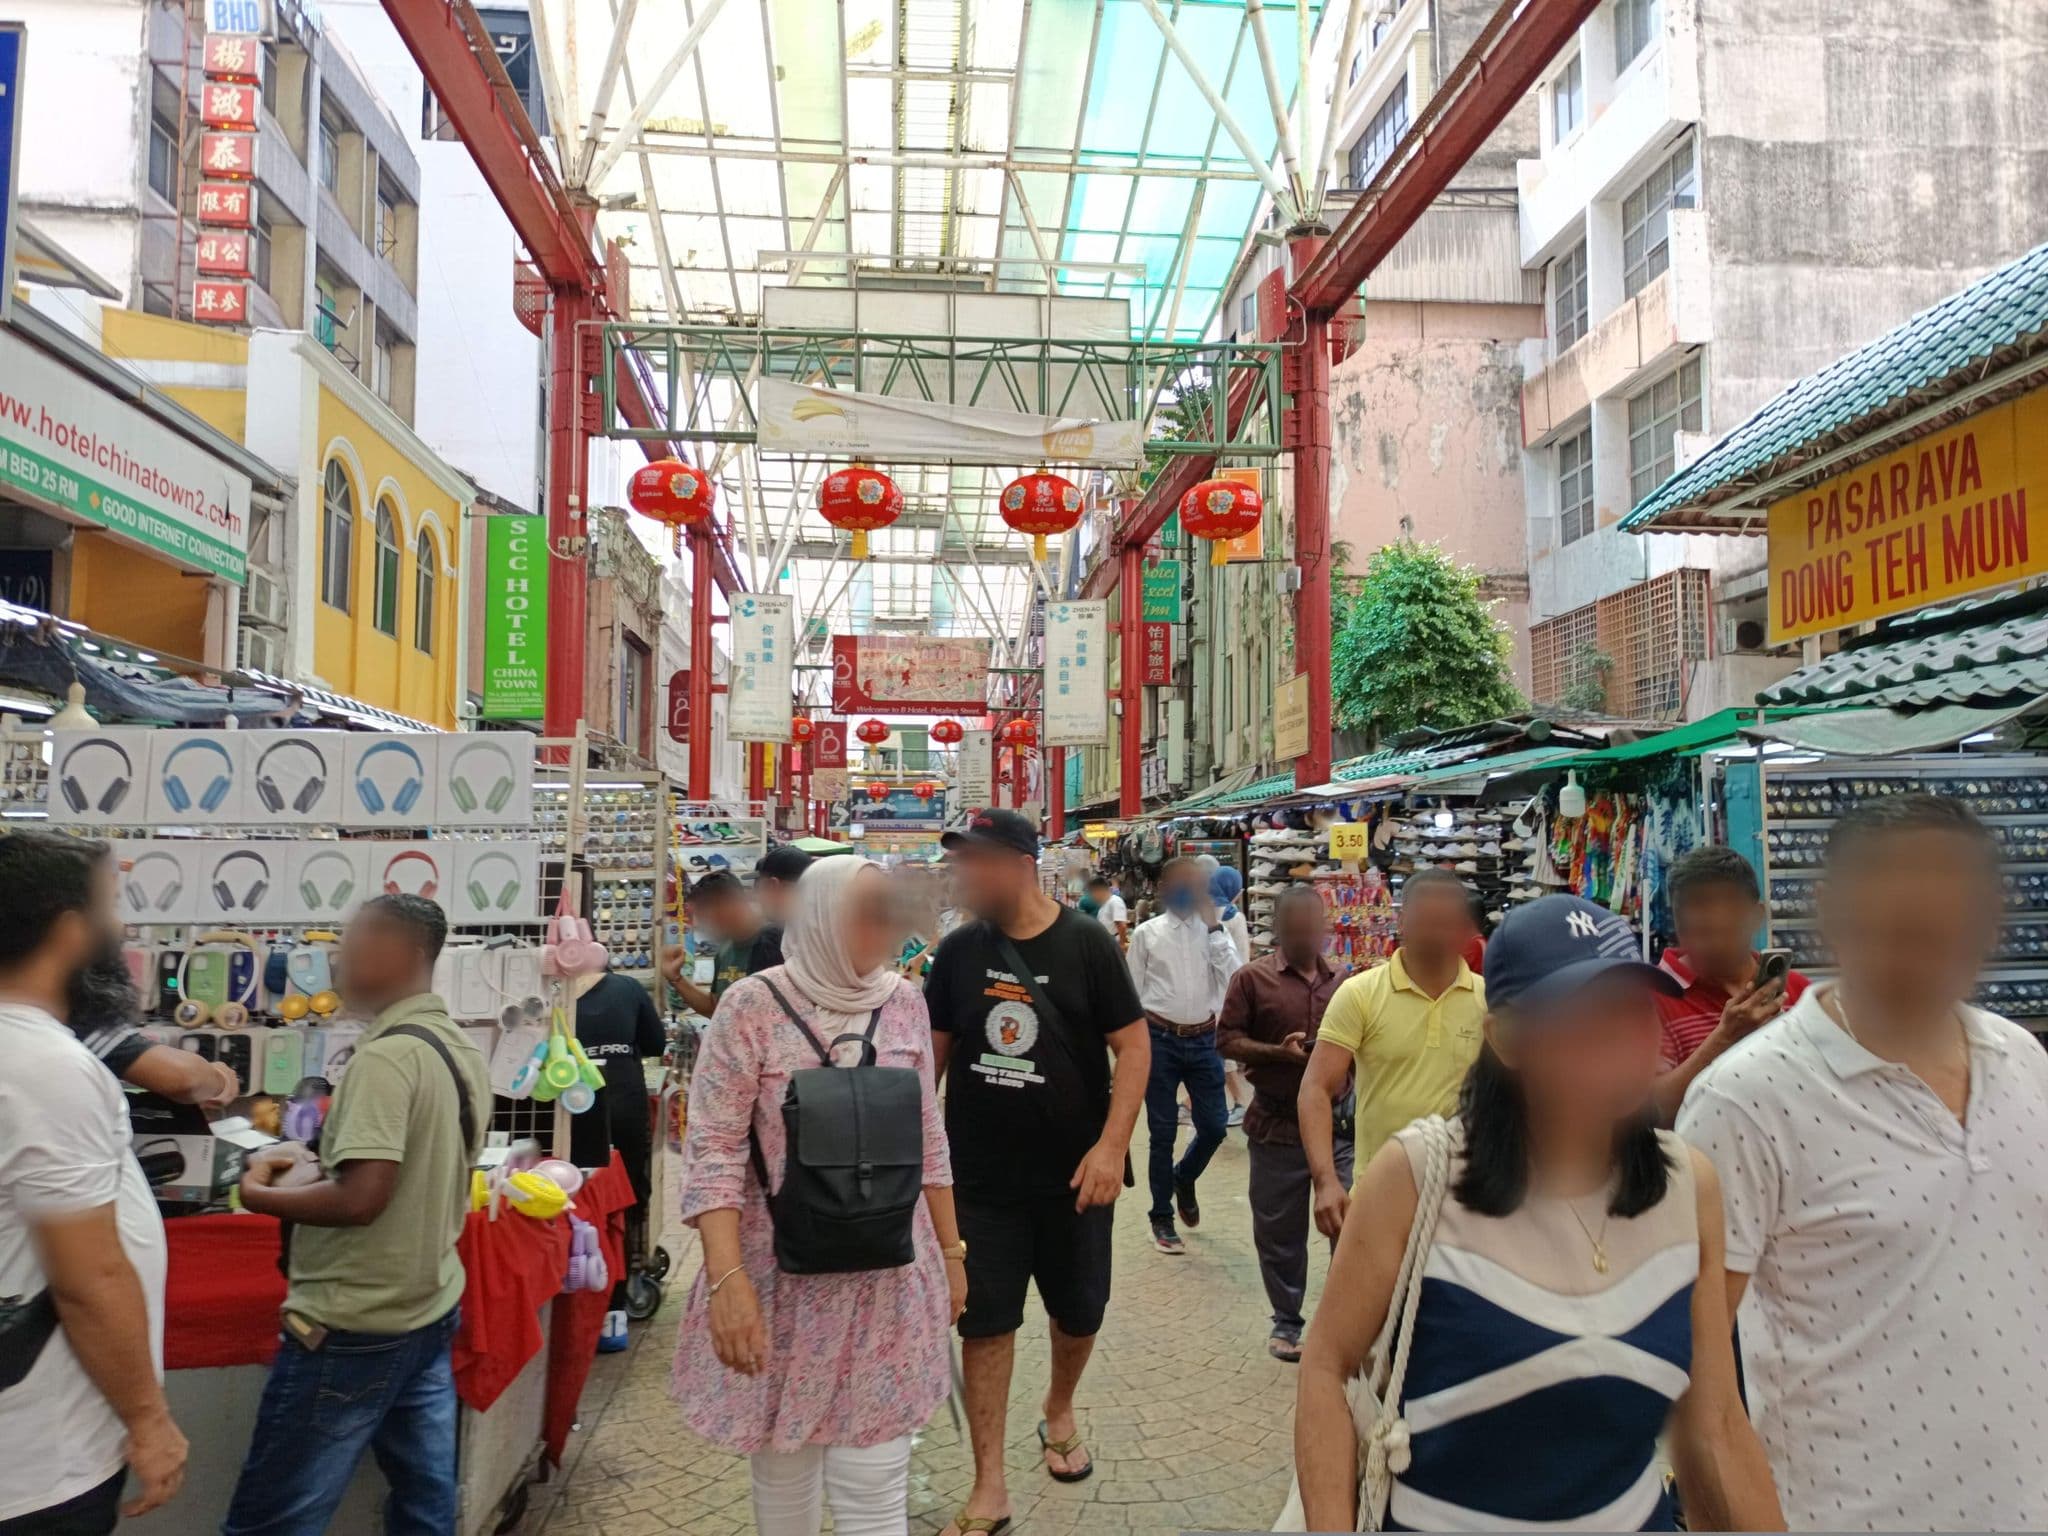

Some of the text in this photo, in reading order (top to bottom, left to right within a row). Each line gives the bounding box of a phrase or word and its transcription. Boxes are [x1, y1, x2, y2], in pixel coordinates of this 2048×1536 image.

[214, 0, 259, 32] BHD
[10, 452, 39, 483] BED
[42, 467, 57, 491] 25
[58, 476, 79, 501] RM
[1808, 432, 1982, 550] PASARAYA
[102, 496, 244, 576] GOOD INTERNET CONNECTION
[509, 520, 528, 571] SCC
[1782, 488, 2029, 629] DONG TEH MUN
[505, 578, 529, 665] HOTEL
[493, 668, 537, 678] CHINA
[494, 679, 538, 689] TOWN
[1336, 834, 1364, 848] 3.50
[1565, 910, 1600, 938] NY
[599, 1043, 631, 1055] PRO
